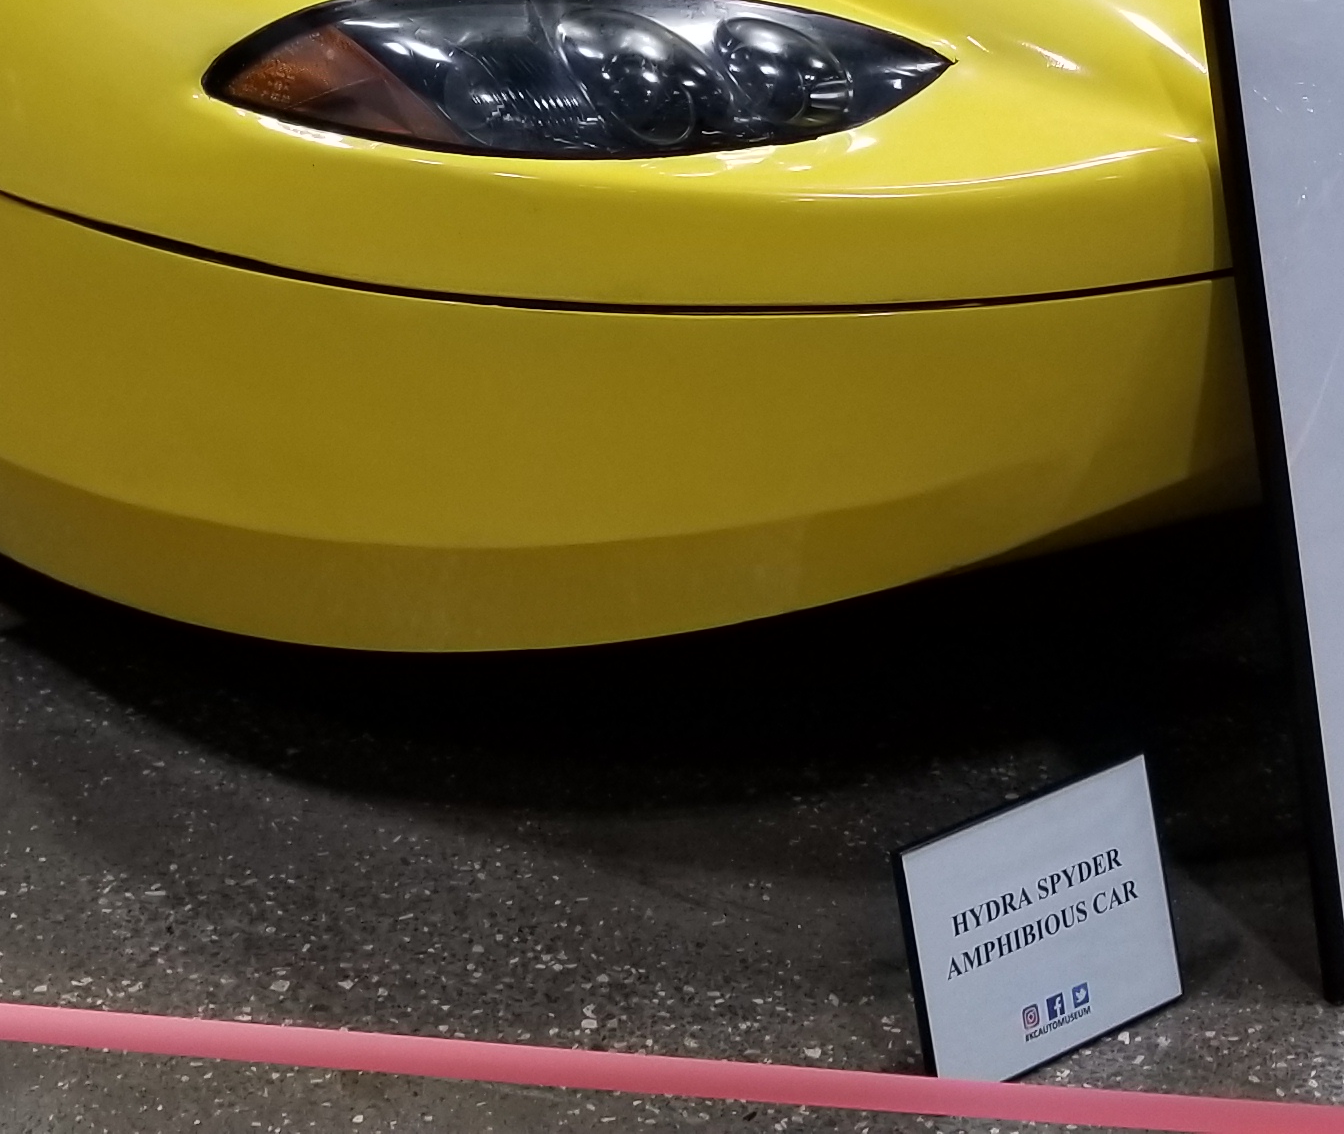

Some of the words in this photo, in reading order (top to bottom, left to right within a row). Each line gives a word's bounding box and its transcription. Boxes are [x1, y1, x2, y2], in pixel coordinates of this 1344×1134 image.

[947, 900, 1088, 981] AMPHIBIOUS
[1092, 879, 1139, 916] CAR
[951, 886, 1033, 938] HYDRA
[1036, 847, 1123, 902] SPYDER
